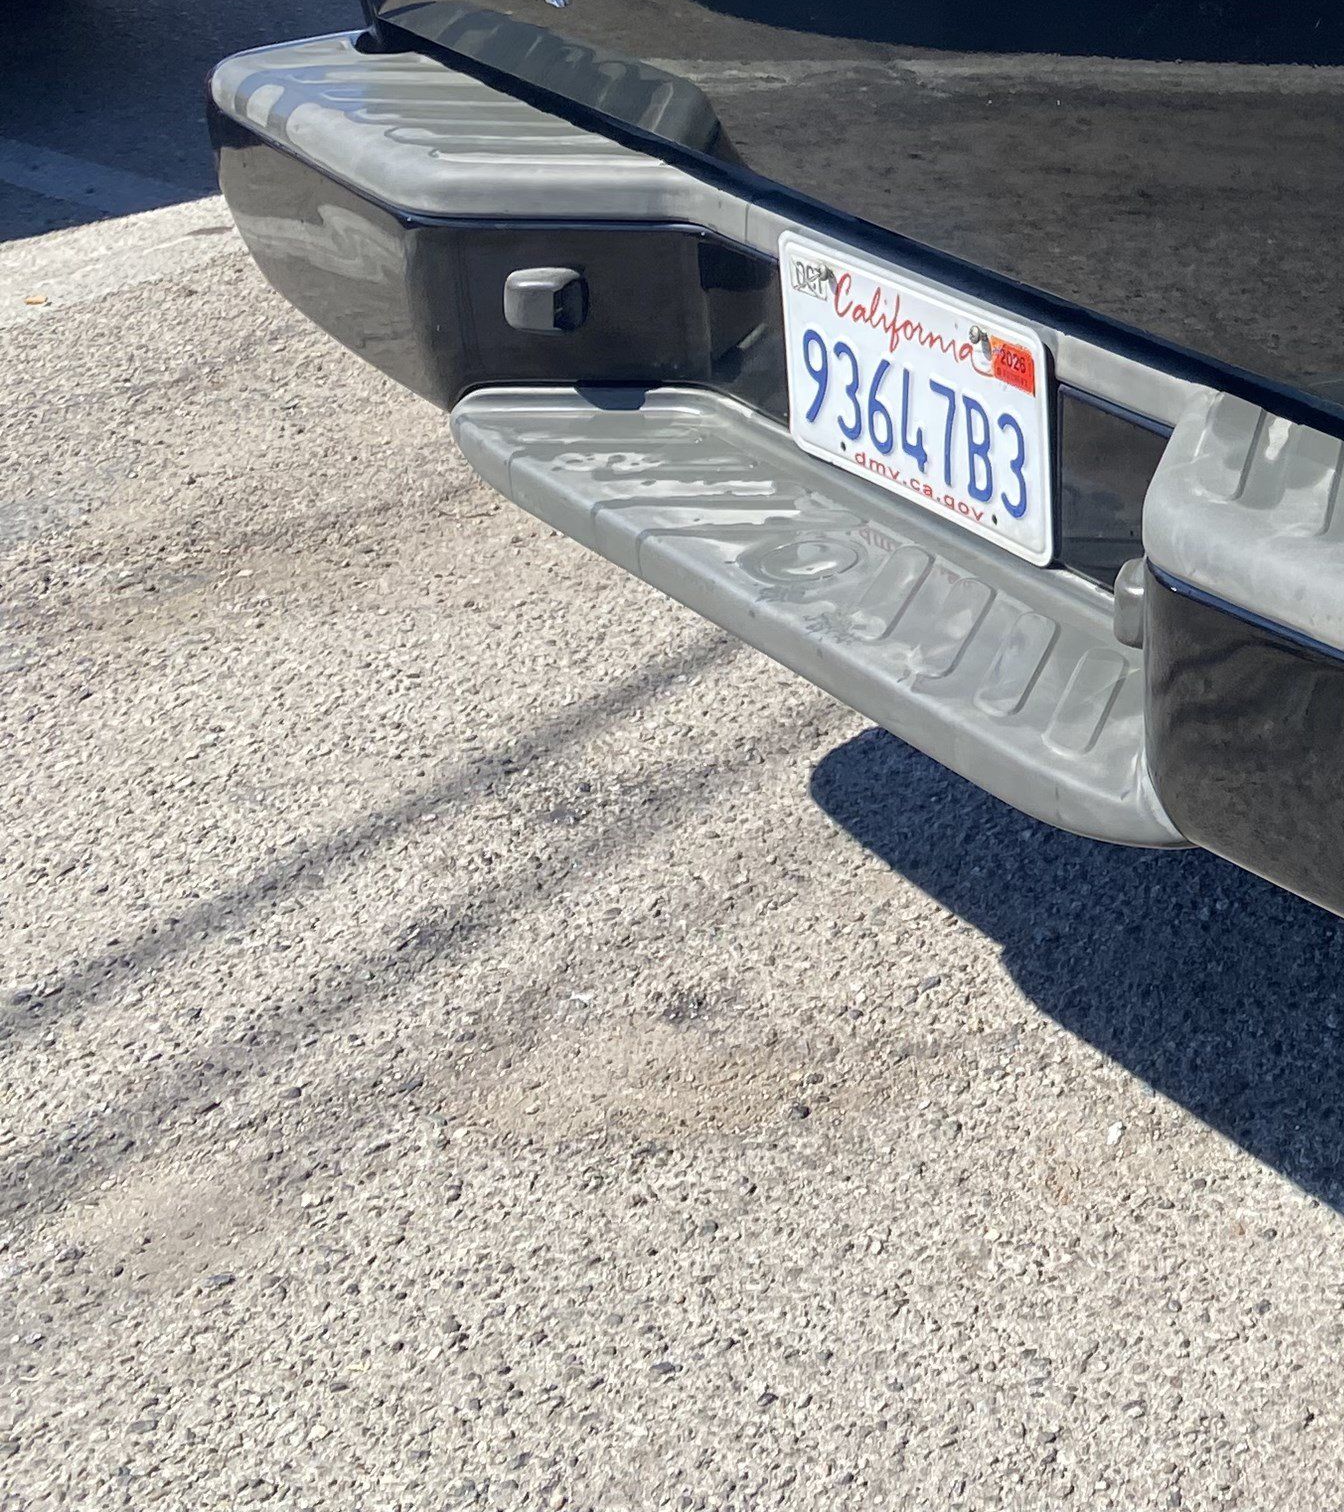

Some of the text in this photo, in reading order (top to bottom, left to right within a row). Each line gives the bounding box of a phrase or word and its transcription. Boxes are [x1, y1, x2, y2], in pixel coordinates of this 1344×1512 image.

[834, 273, 994, 378] California
[1000, 344, 1027, 374] 2026
[802, 328, 1028, 519] 93647B3
[854, 450, 984, 522] dmv.ca.gov
